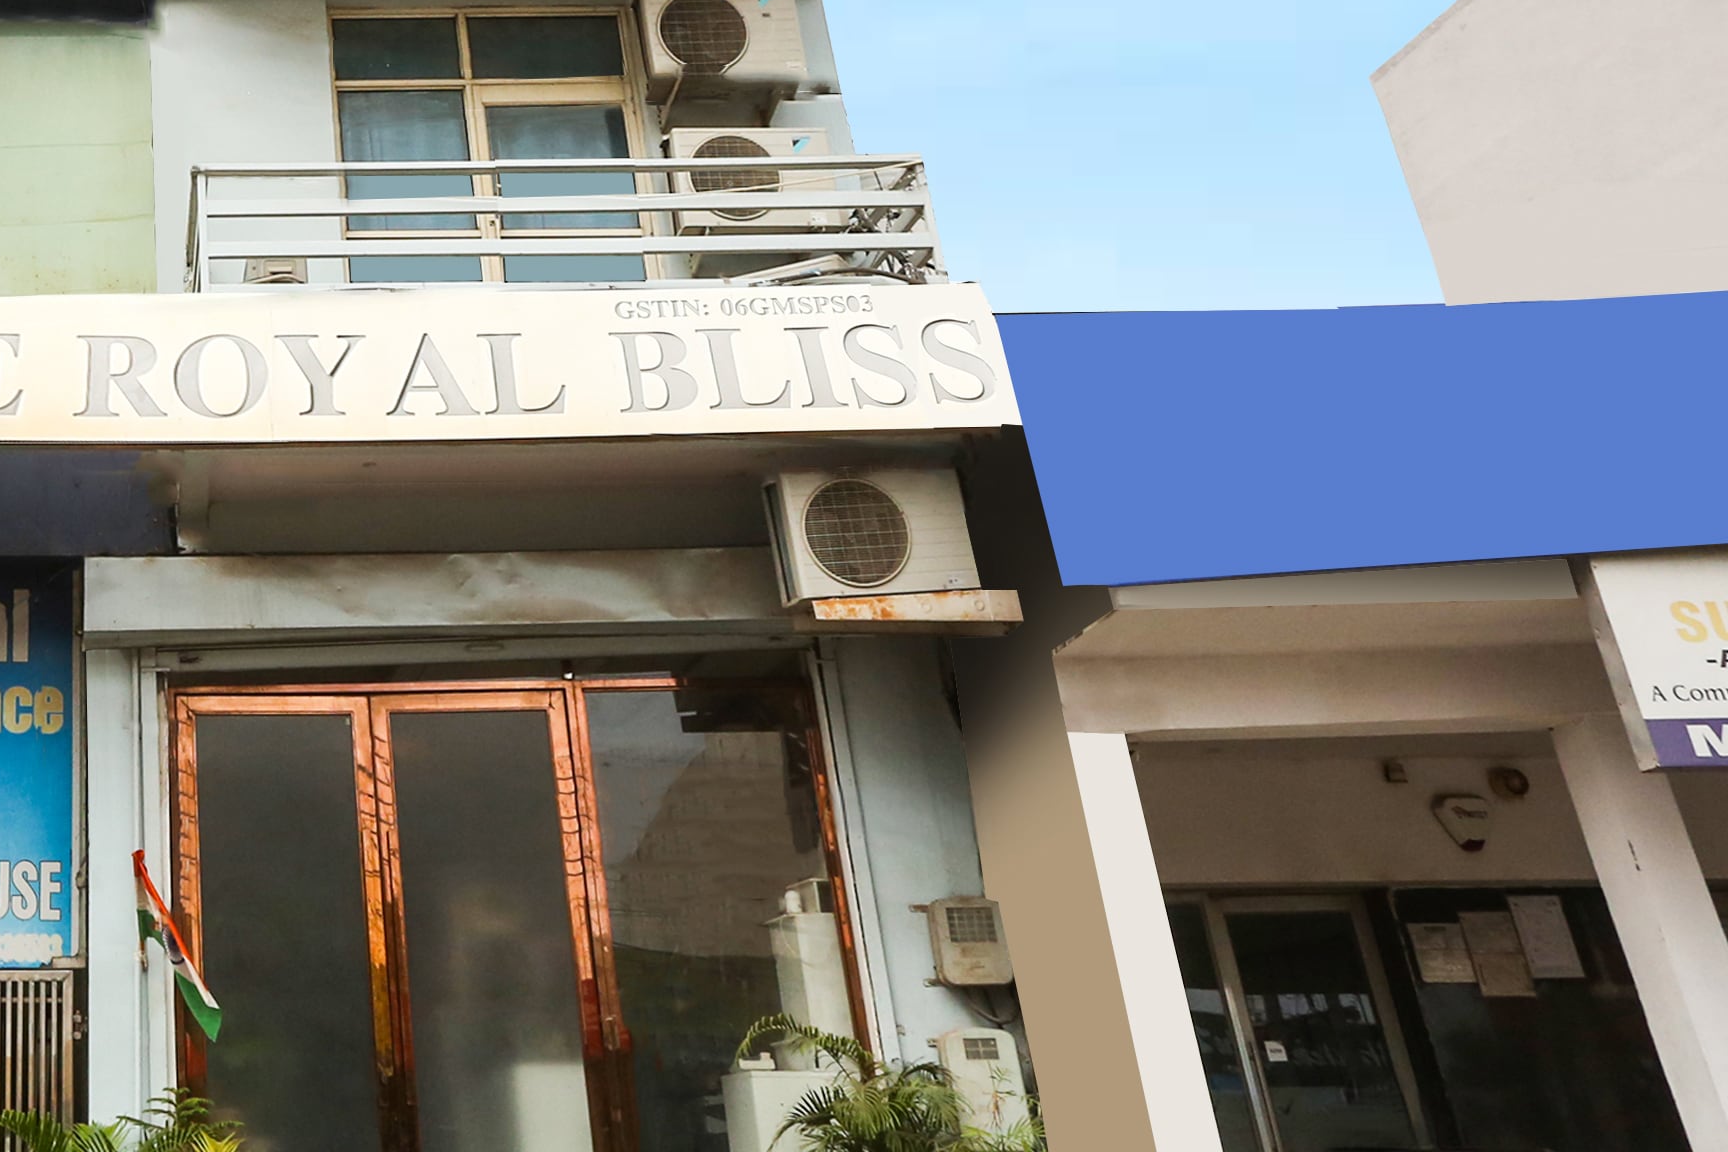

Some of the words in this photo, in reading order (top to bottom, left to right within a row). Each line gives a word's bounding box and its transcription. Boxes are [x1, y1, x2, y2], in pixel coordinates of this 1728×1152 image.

[614, 298, 711, 319] GSTIN:
[72, 333, 567, 418] ROYAL
[608, 319, 997, 414] BLISS
[1652, 685, 1667, 701] A
[1672, 684, 1728, 702] Com
